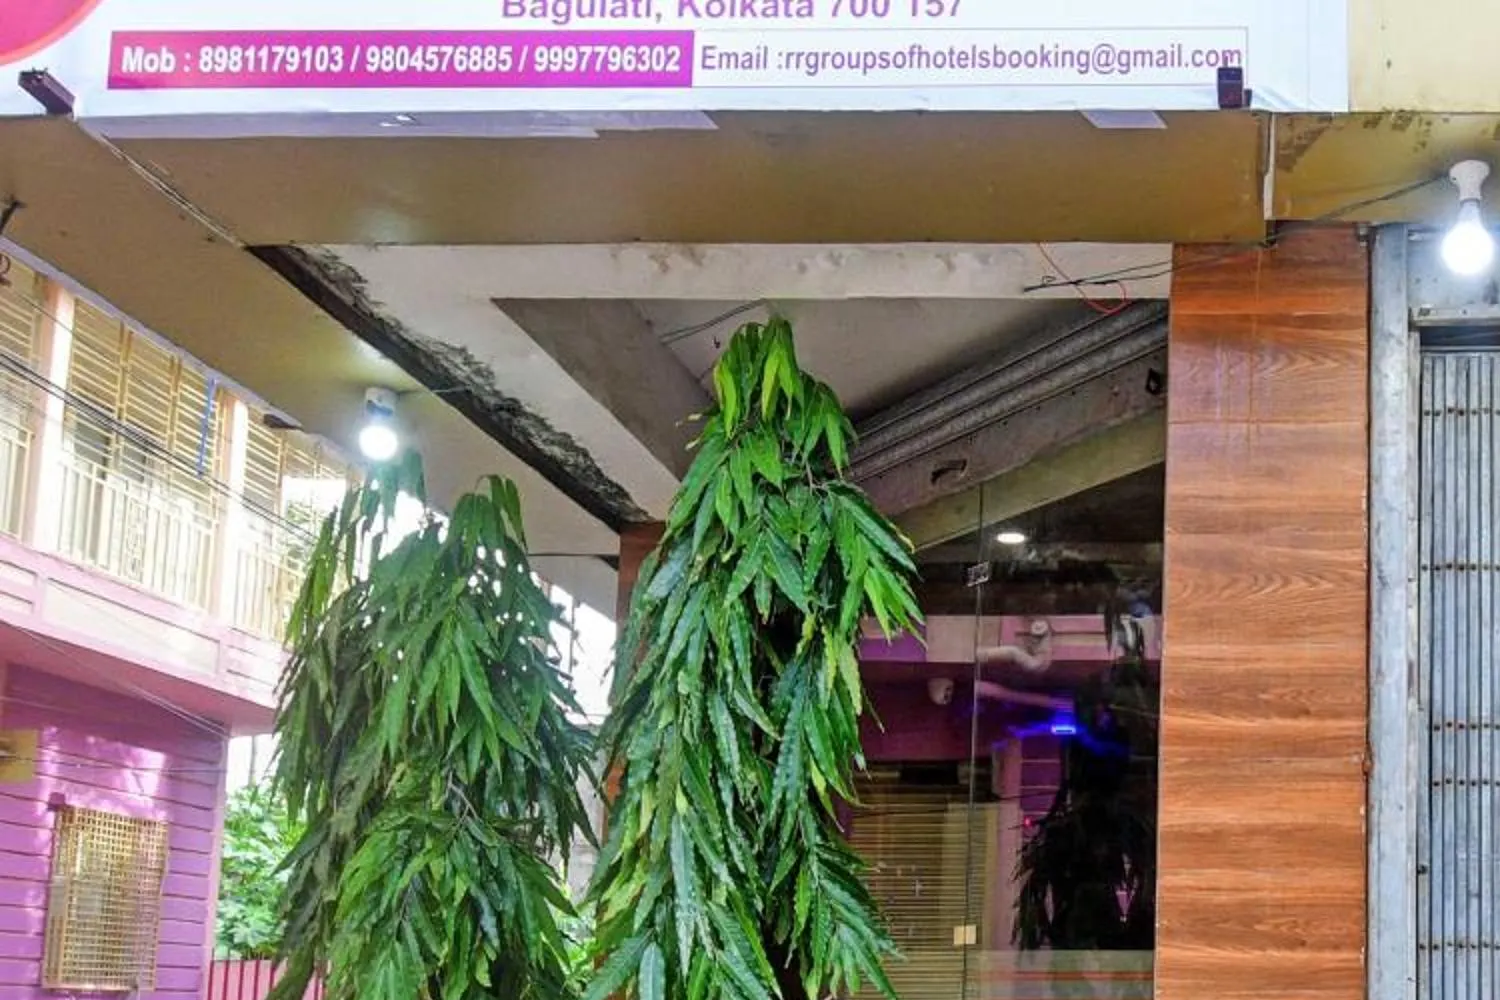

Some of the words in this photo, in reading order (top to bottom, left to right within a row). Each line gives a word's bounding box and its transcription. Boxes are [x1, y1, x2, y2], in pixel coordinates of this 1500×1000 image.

[122, 45, 176, 72] Mob
[199, 45, 344, 72] 8981179103
[349, 45, 361, 72] /
[366, 45, 512, 72] 9804576885
[518, 45, 529, 72] /
[534, 45, 681, 72] 9997796302
[701, 45, 768, 70] Email
